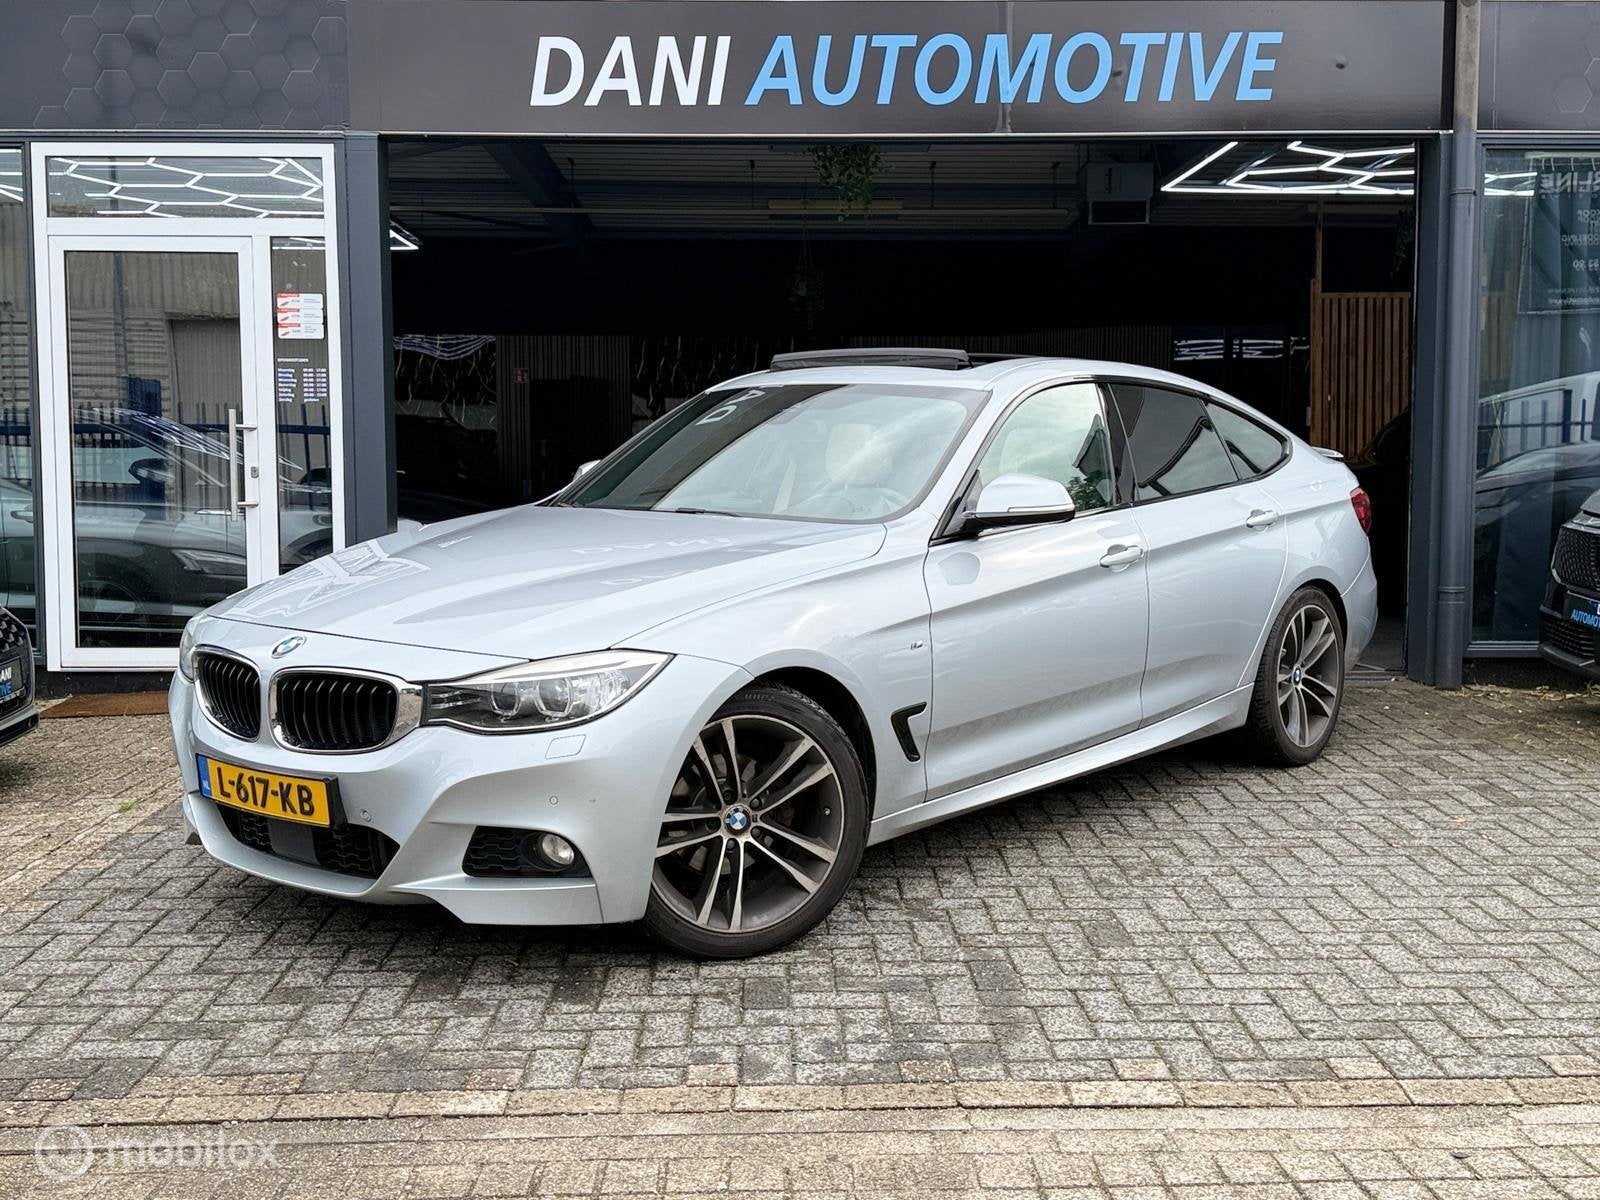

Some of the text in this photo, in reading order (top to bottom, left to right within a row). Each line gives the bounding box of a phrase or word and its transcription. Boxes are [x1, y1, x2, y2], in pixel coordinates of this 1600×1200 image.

[530, 30, 1284, 107] DANI AUTOMOTIVE
[1570, 608, 1600, 628] AUTOMO
[216, 766, 315, 816] L-617-KB
